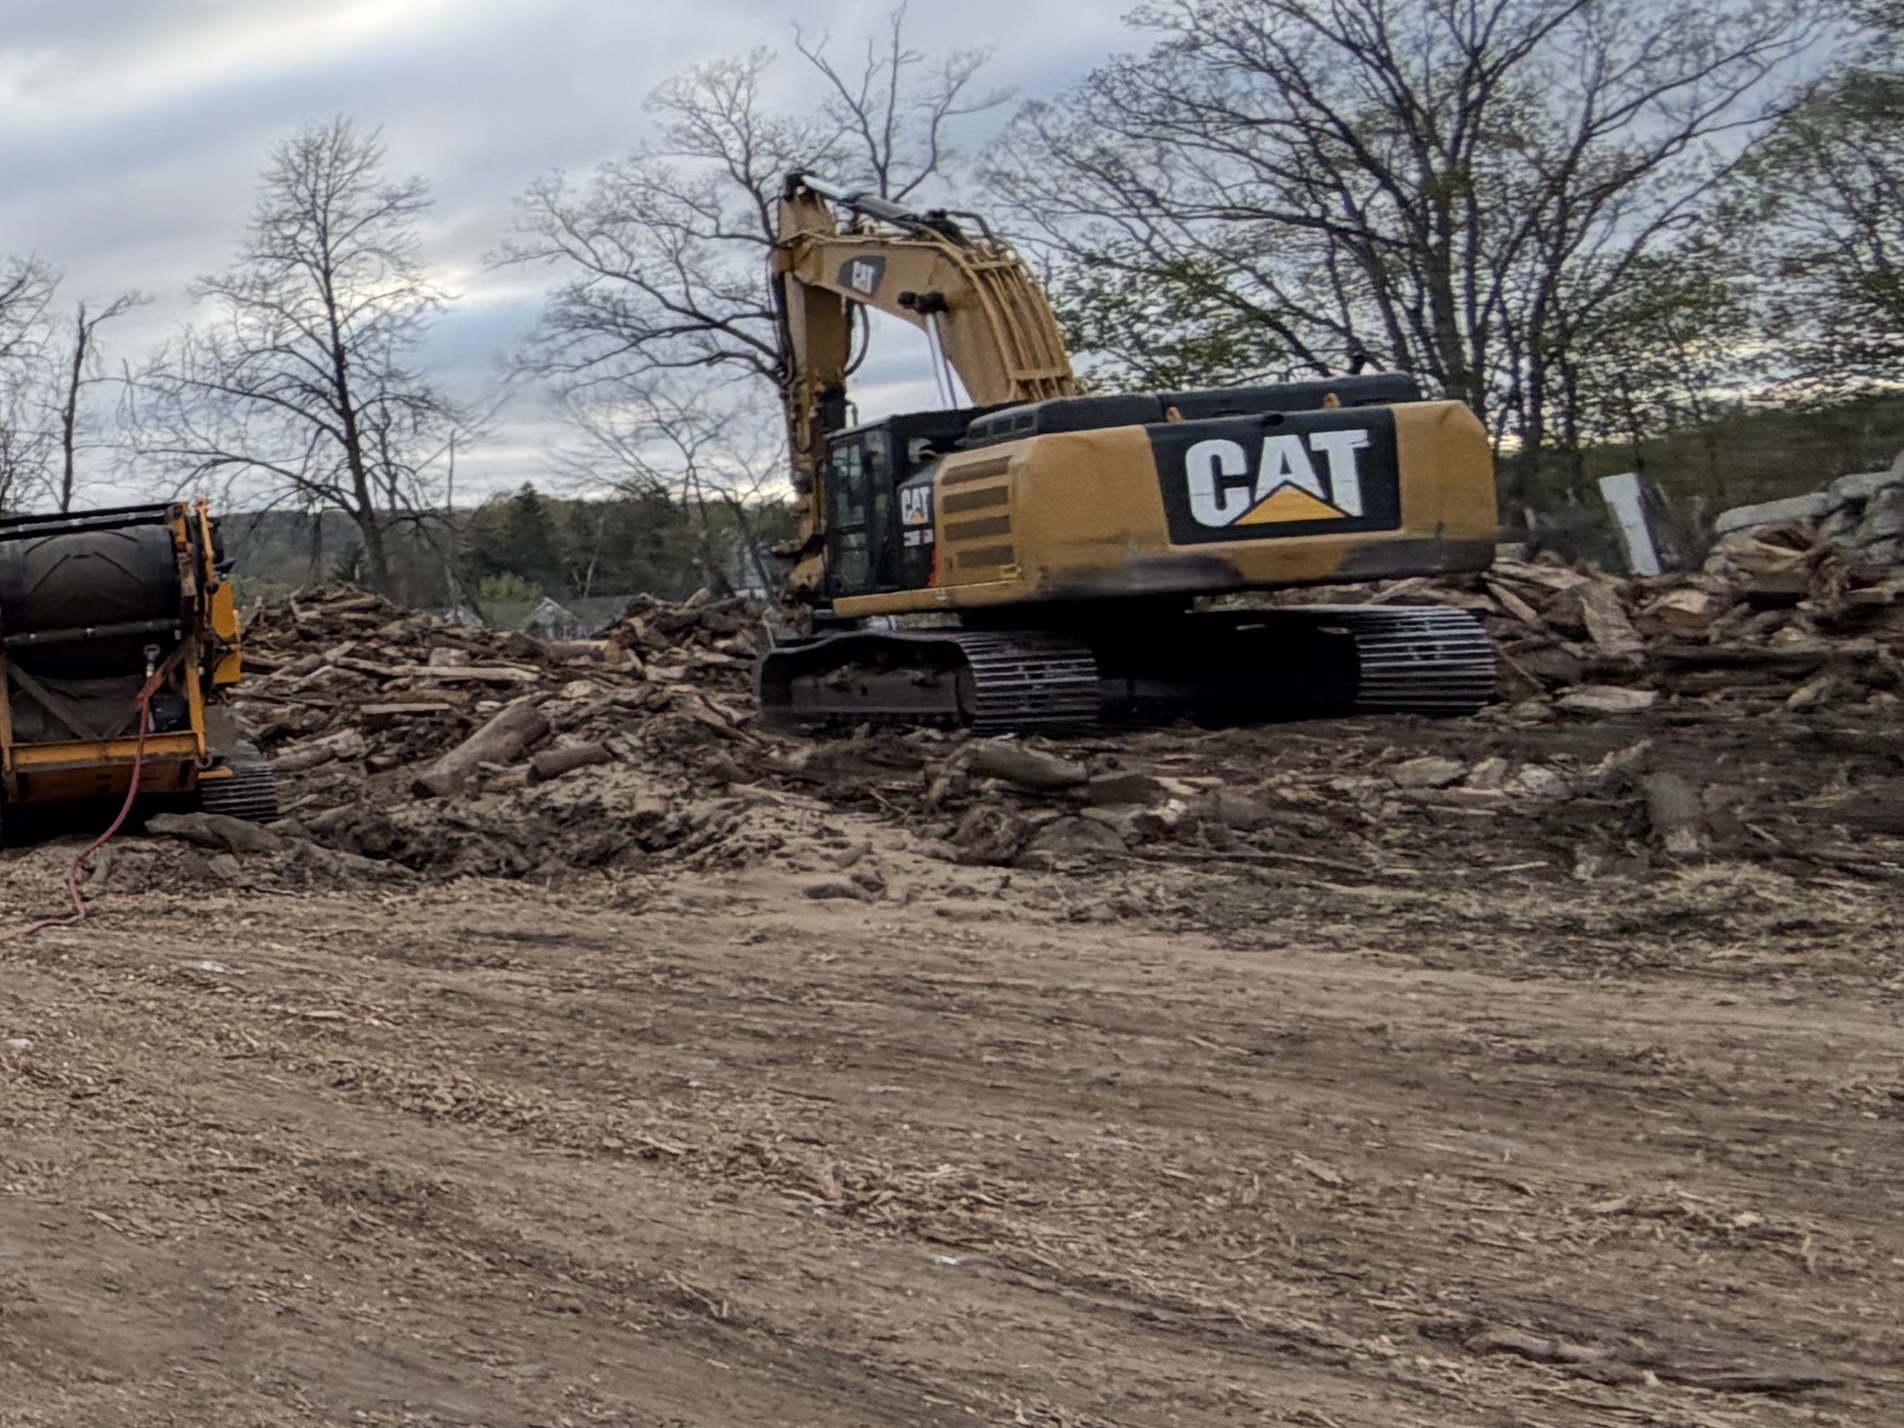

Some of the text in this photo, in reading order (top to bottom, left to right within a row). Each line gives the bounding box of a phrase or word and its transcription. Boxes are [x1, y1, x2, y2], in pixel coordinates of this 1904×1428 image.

[852, 260, 876, 294] CAT
[1185, 429, 1371, 528] CAT
[901, 486, 931, 526] CAT
